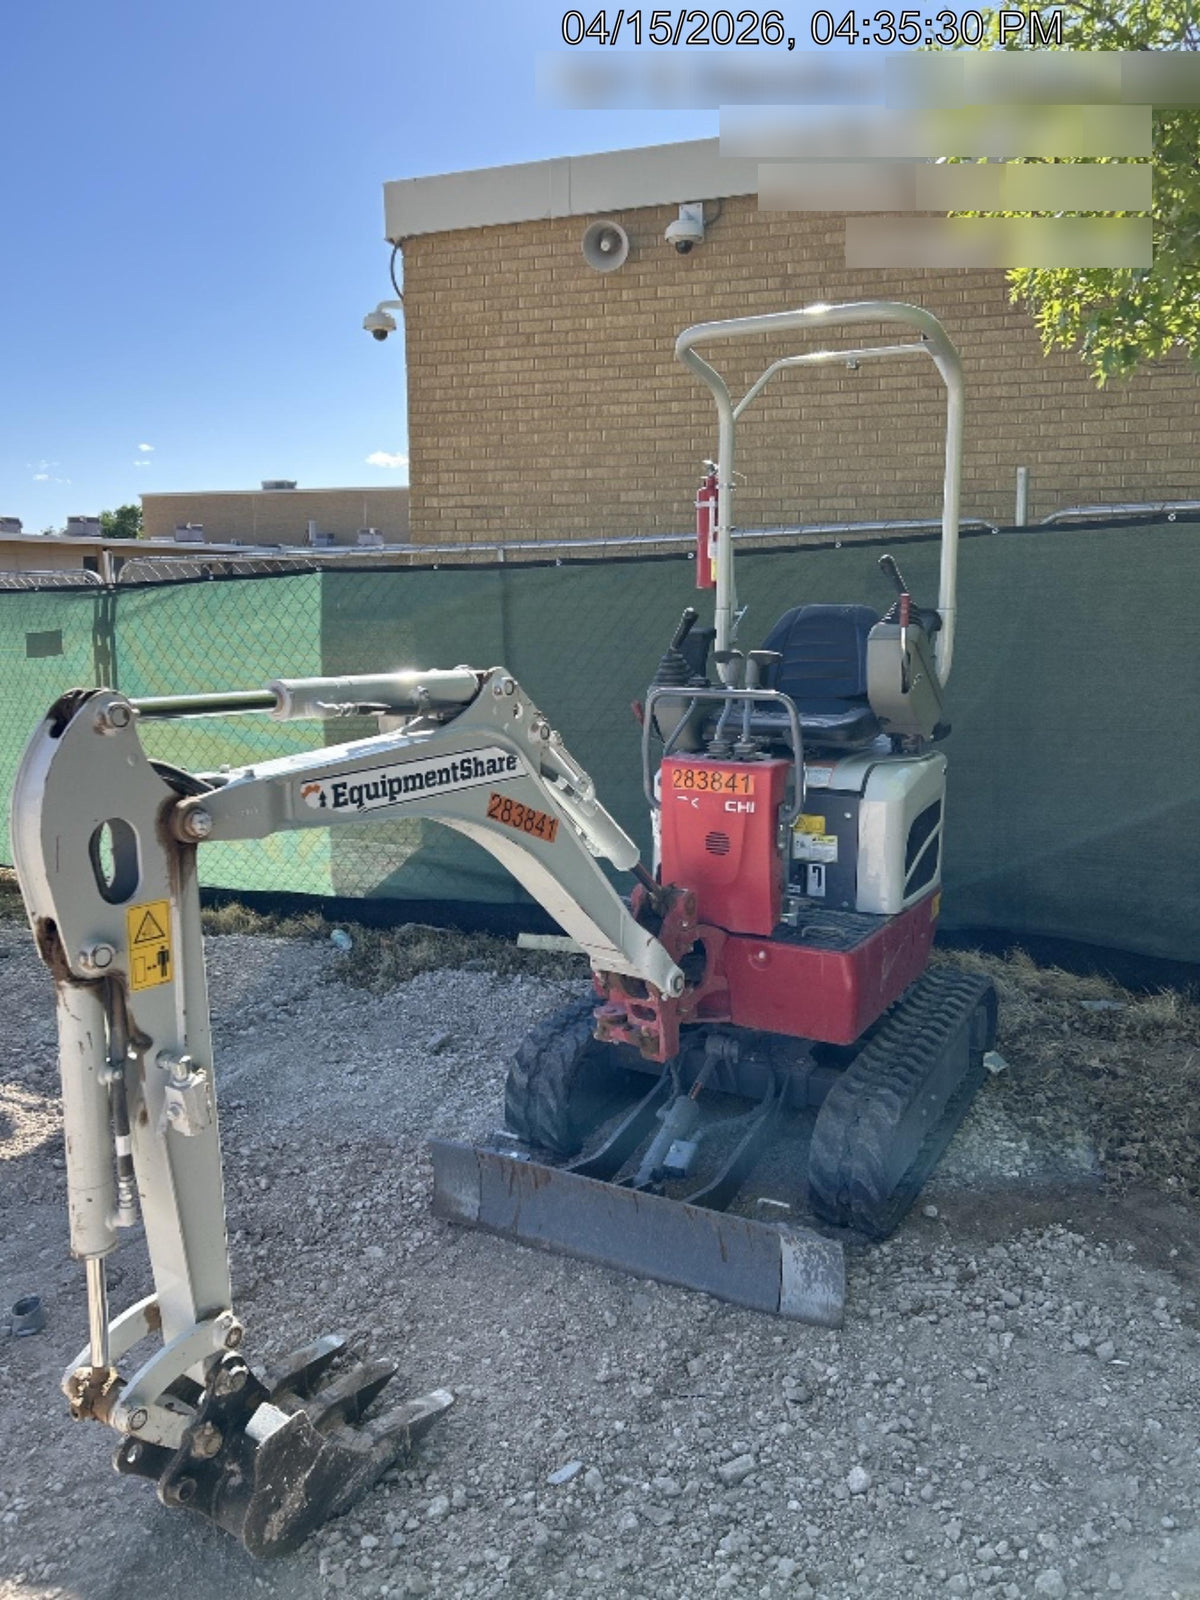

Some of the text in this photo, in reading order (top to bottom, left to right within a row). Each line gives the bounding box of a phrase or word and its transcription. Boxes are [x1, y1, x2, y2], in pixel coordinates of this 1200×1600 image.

[331, 752, 518, 810] EquipmentShare
[672, 769, 752, 795] 283841
[487, 793, 557, 838] 283841
